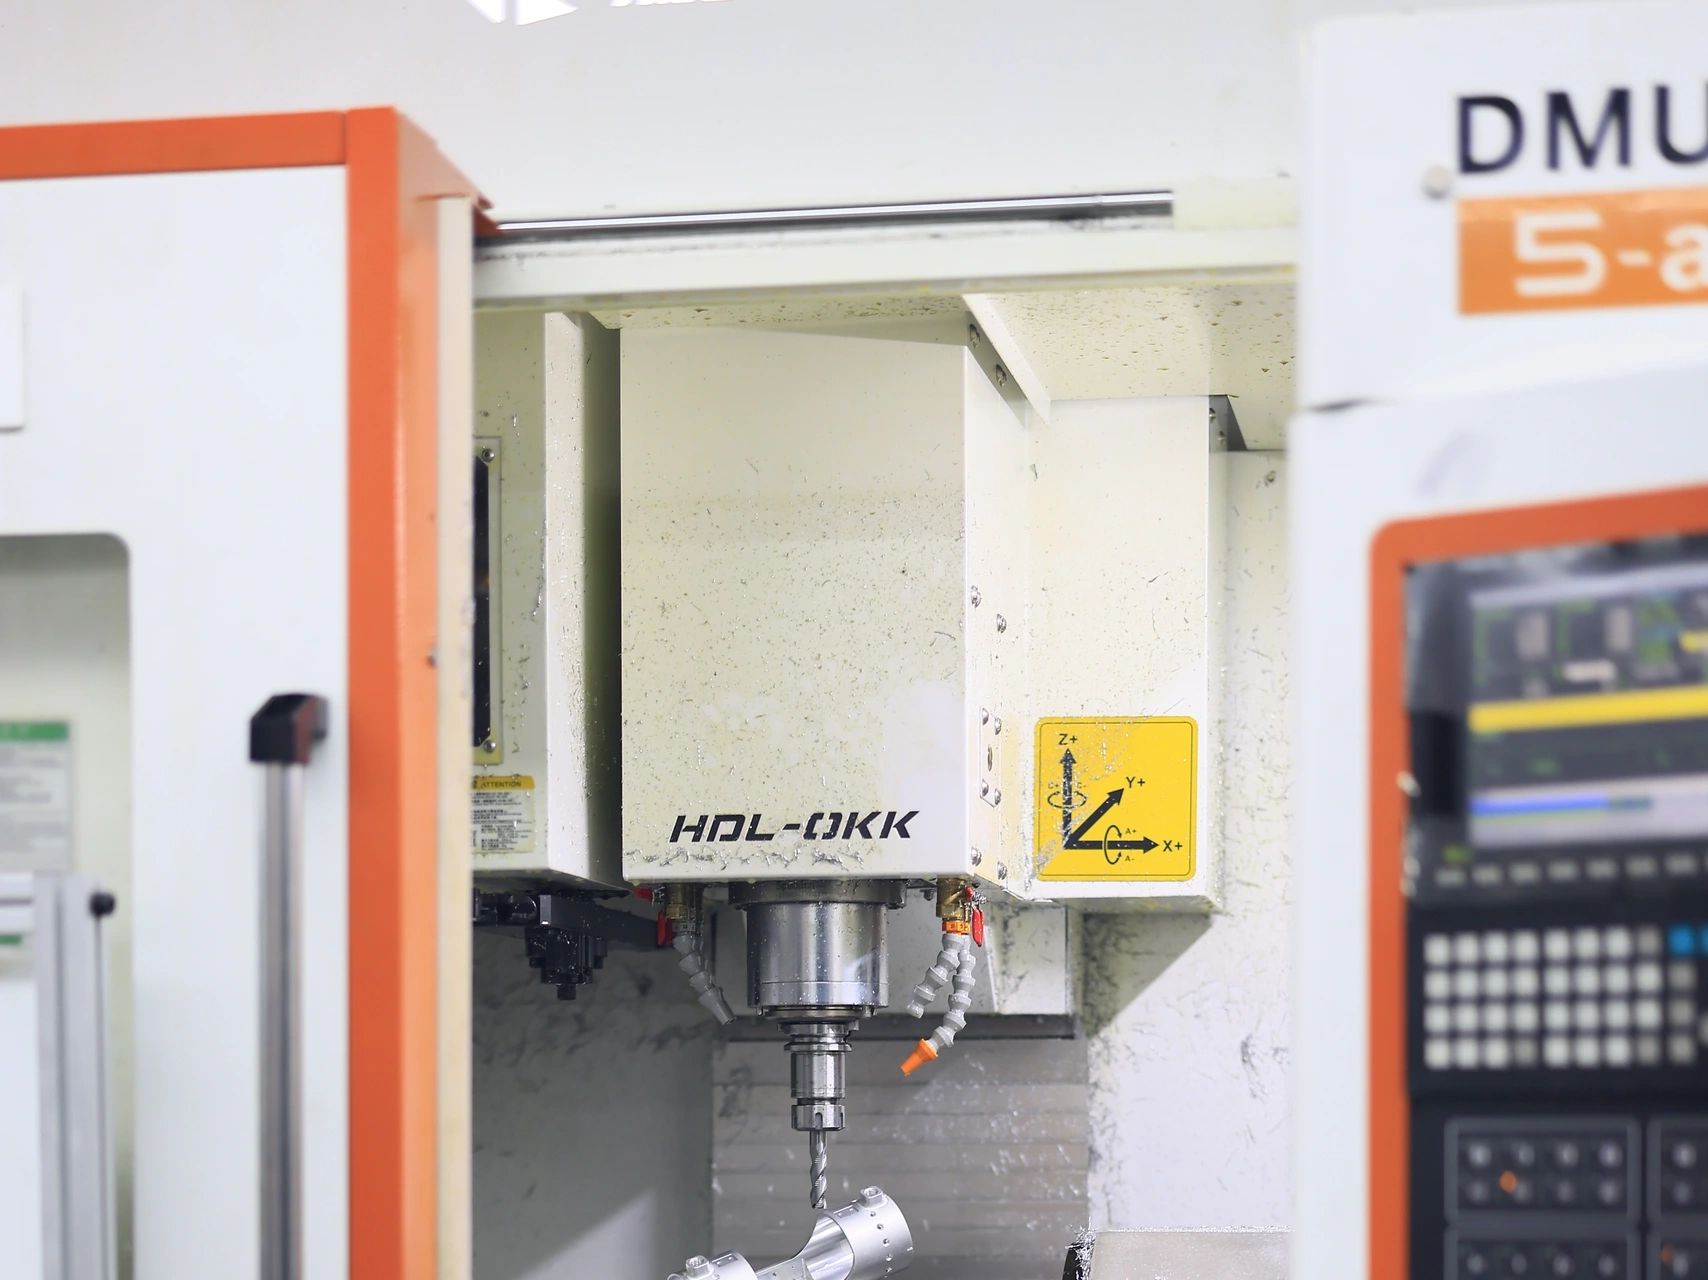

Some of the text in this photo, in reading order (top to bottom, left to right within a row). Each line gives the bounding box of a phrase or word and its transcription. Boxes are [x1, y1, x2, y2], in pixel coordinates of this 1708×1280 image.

[1058, 733, 1078, 746] Z+
[1126, 776, 1146, 789] Y+
[1163, 840, 1183, 852] X+
